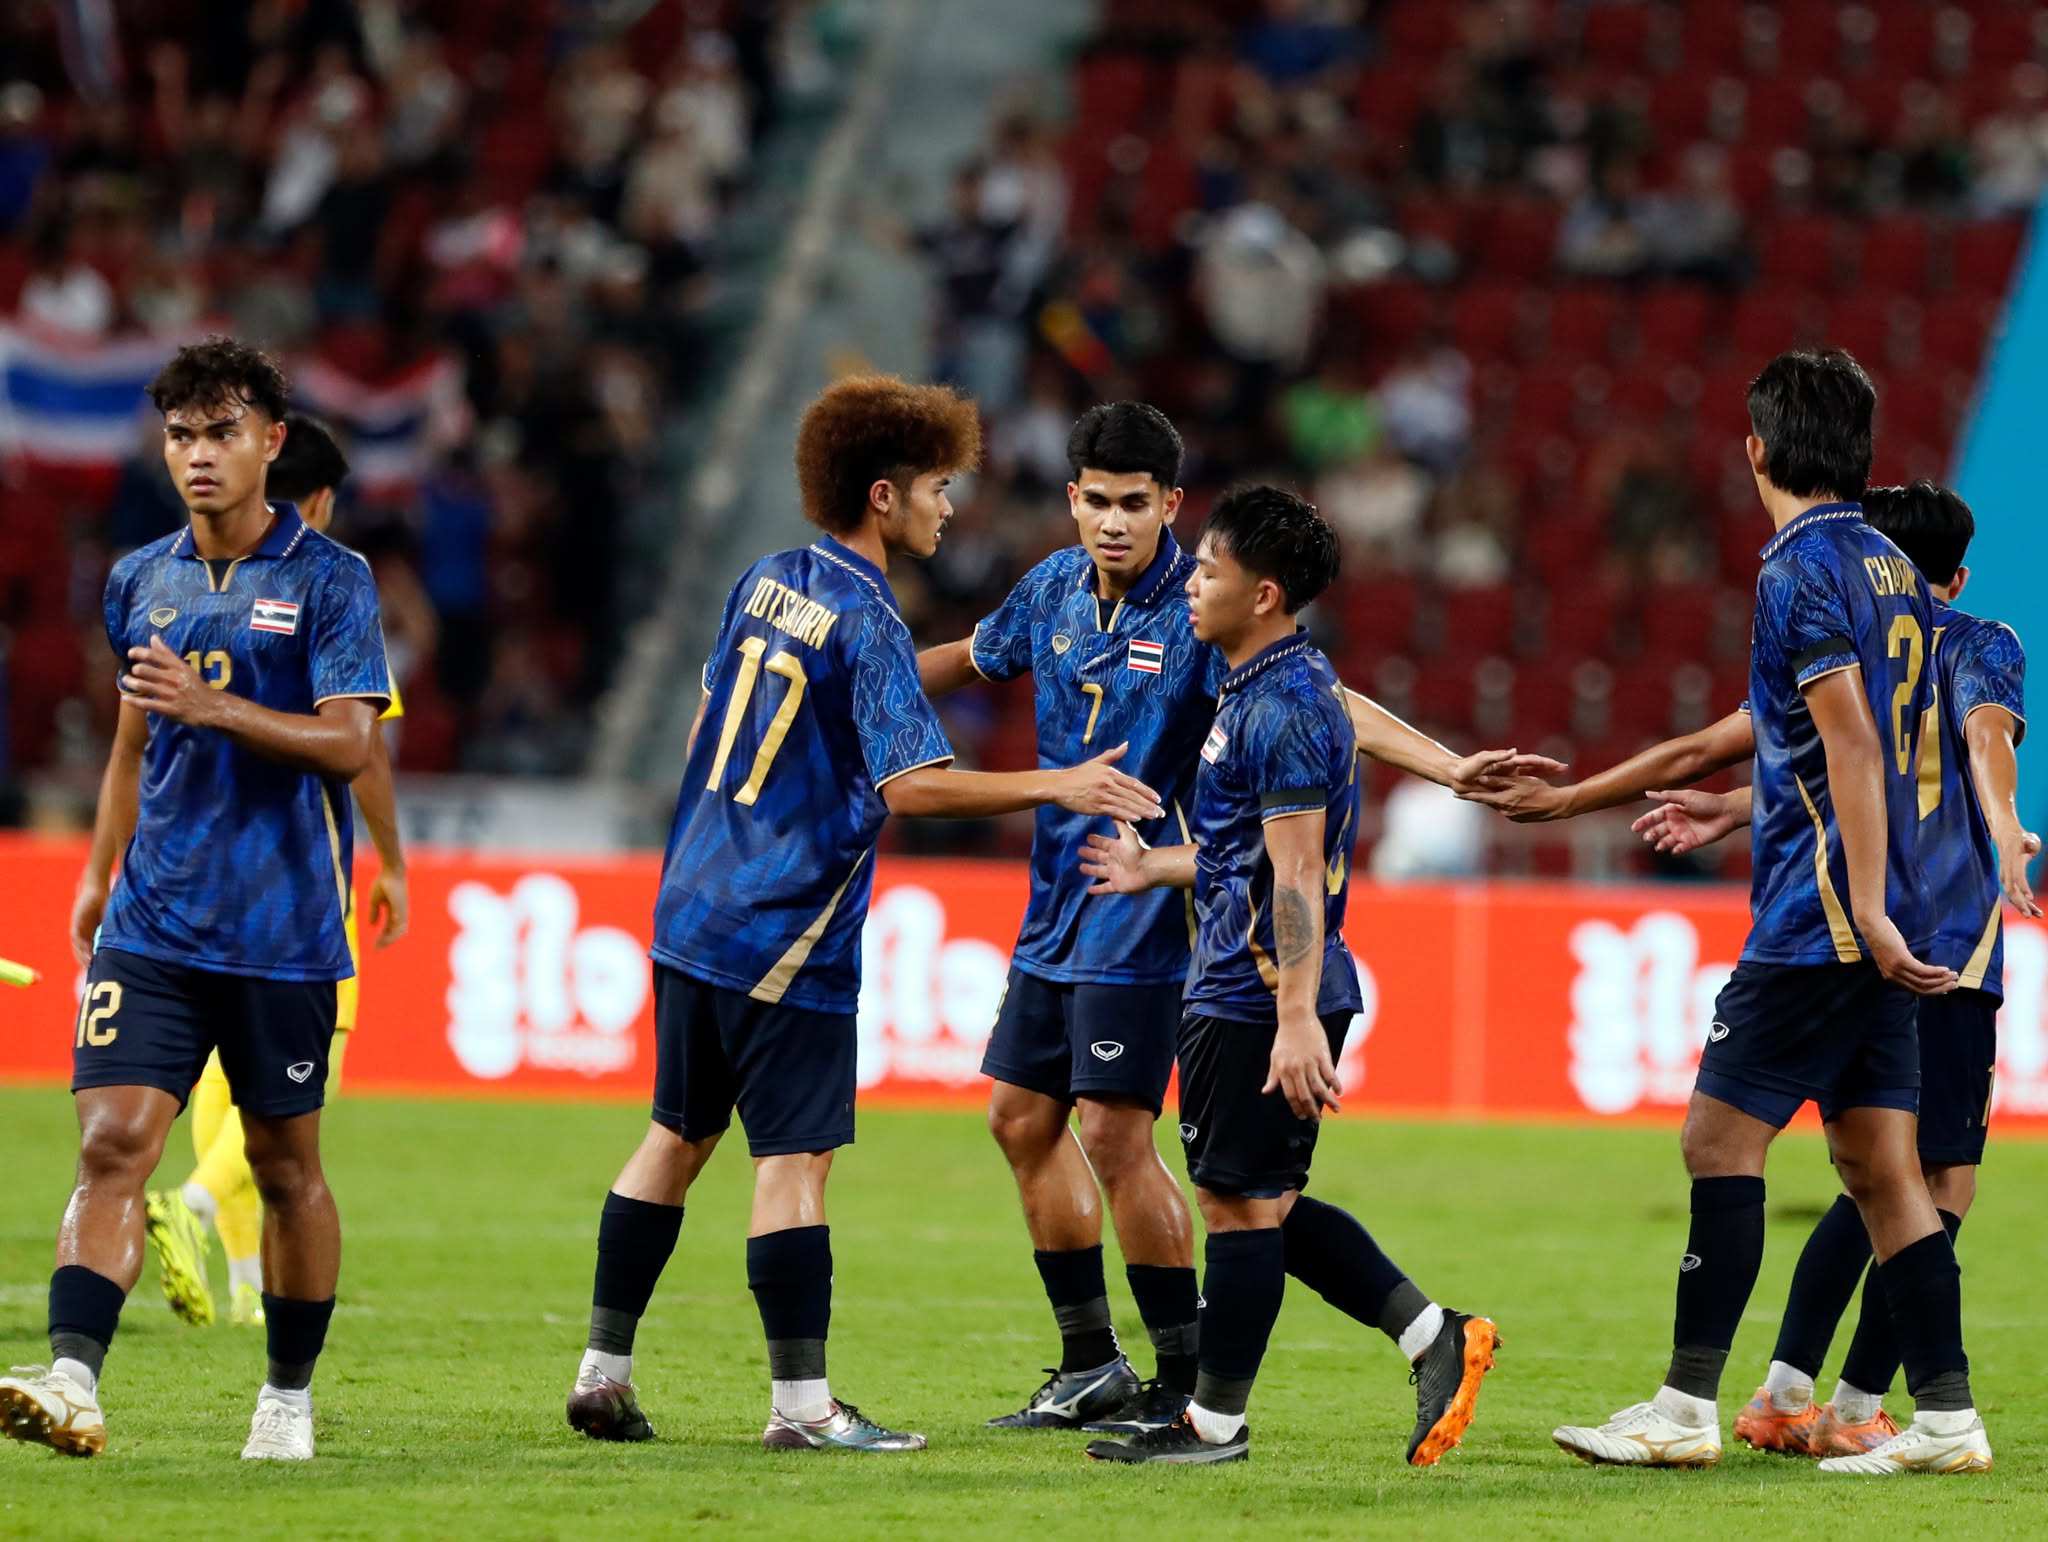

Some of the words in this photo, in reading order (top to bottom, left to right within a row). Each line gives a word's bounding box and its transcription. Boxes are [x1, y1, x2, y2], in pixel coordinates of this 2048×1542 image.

[707, 636, 808, 806] 17
[1081, 683, 1103, 744] 7
[76, 980, 122, 1048] 12
